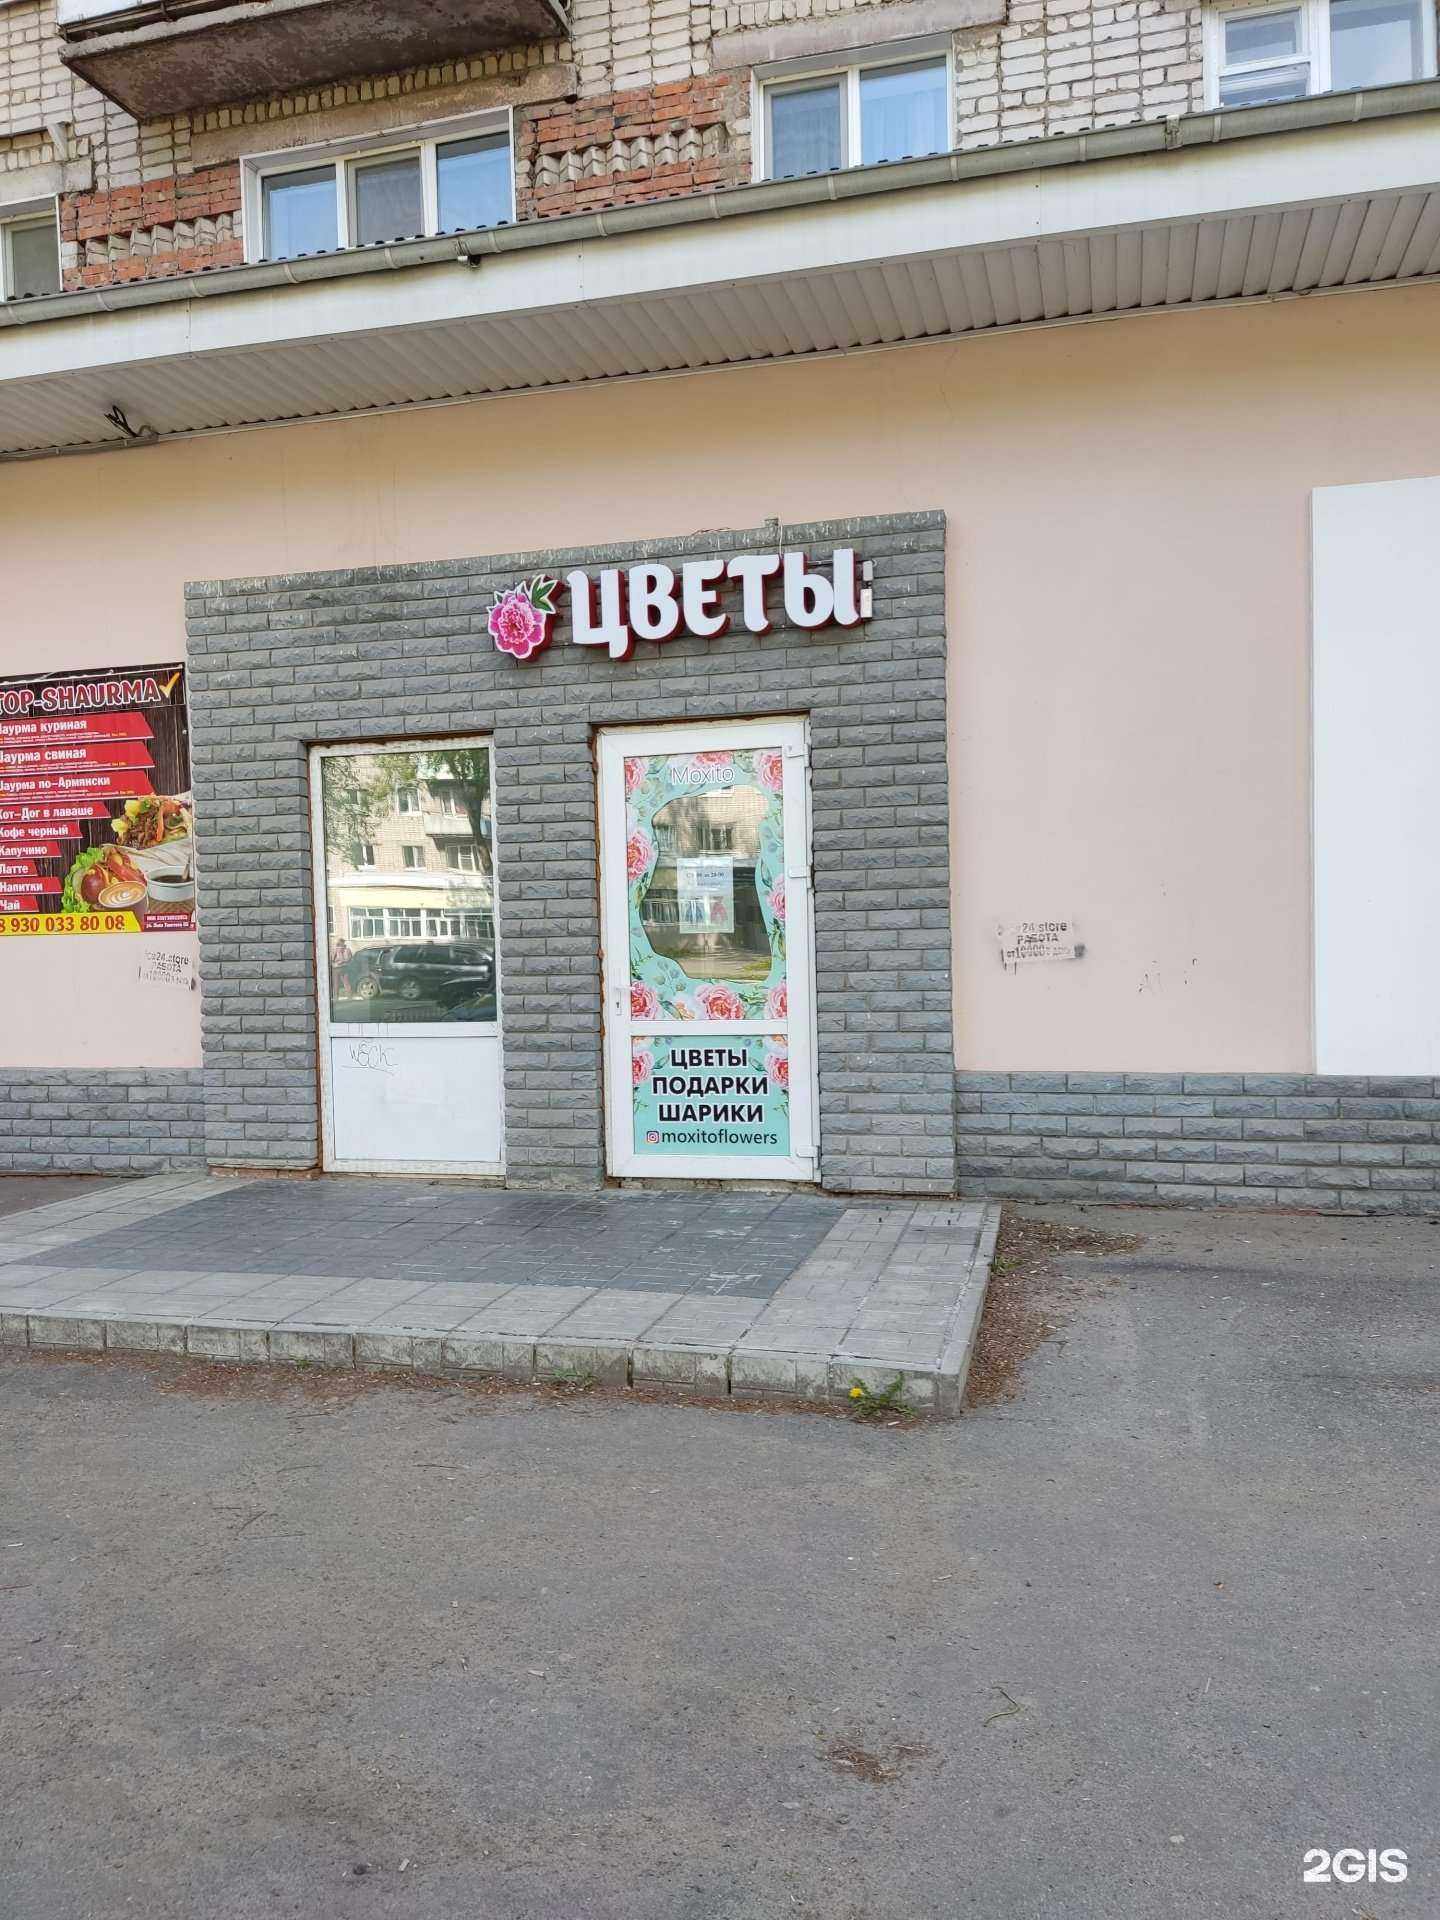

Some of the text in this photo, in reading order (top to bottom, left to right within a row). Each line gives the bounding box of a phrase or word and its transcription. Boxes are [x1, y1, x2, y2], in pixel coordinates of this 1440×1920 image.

[566, 548, 861, 660] ЦВЕТЫ
[40, 719, 87, 734] куриная
[44, 748, 87, 761] свиная
[671, 764, 735, 785] Moxito
[43, 809, 50, 818] в
[53, 805, 93, 817] лаваше
[28, 824, 69, 837] черный
[0, 863, 29, 874] Латте
[0, 881, 43, 892] Напитки
[0, 899, 20, 911] Чай
[11, 917, 39, 932] 930
[46, 916, 74, 932] 033
[80, 915, 100, 931] 80
[105, 914, 125, 930] 08
[670, 1048, 748, 1070] ЦВЕТЫ
[652, 1076, 769, 1098] ПОДАРКИ
[658, 1103, 764, 1123] ШАРИКИ
[661, 1128, 778, 1145] moxitoflowers
